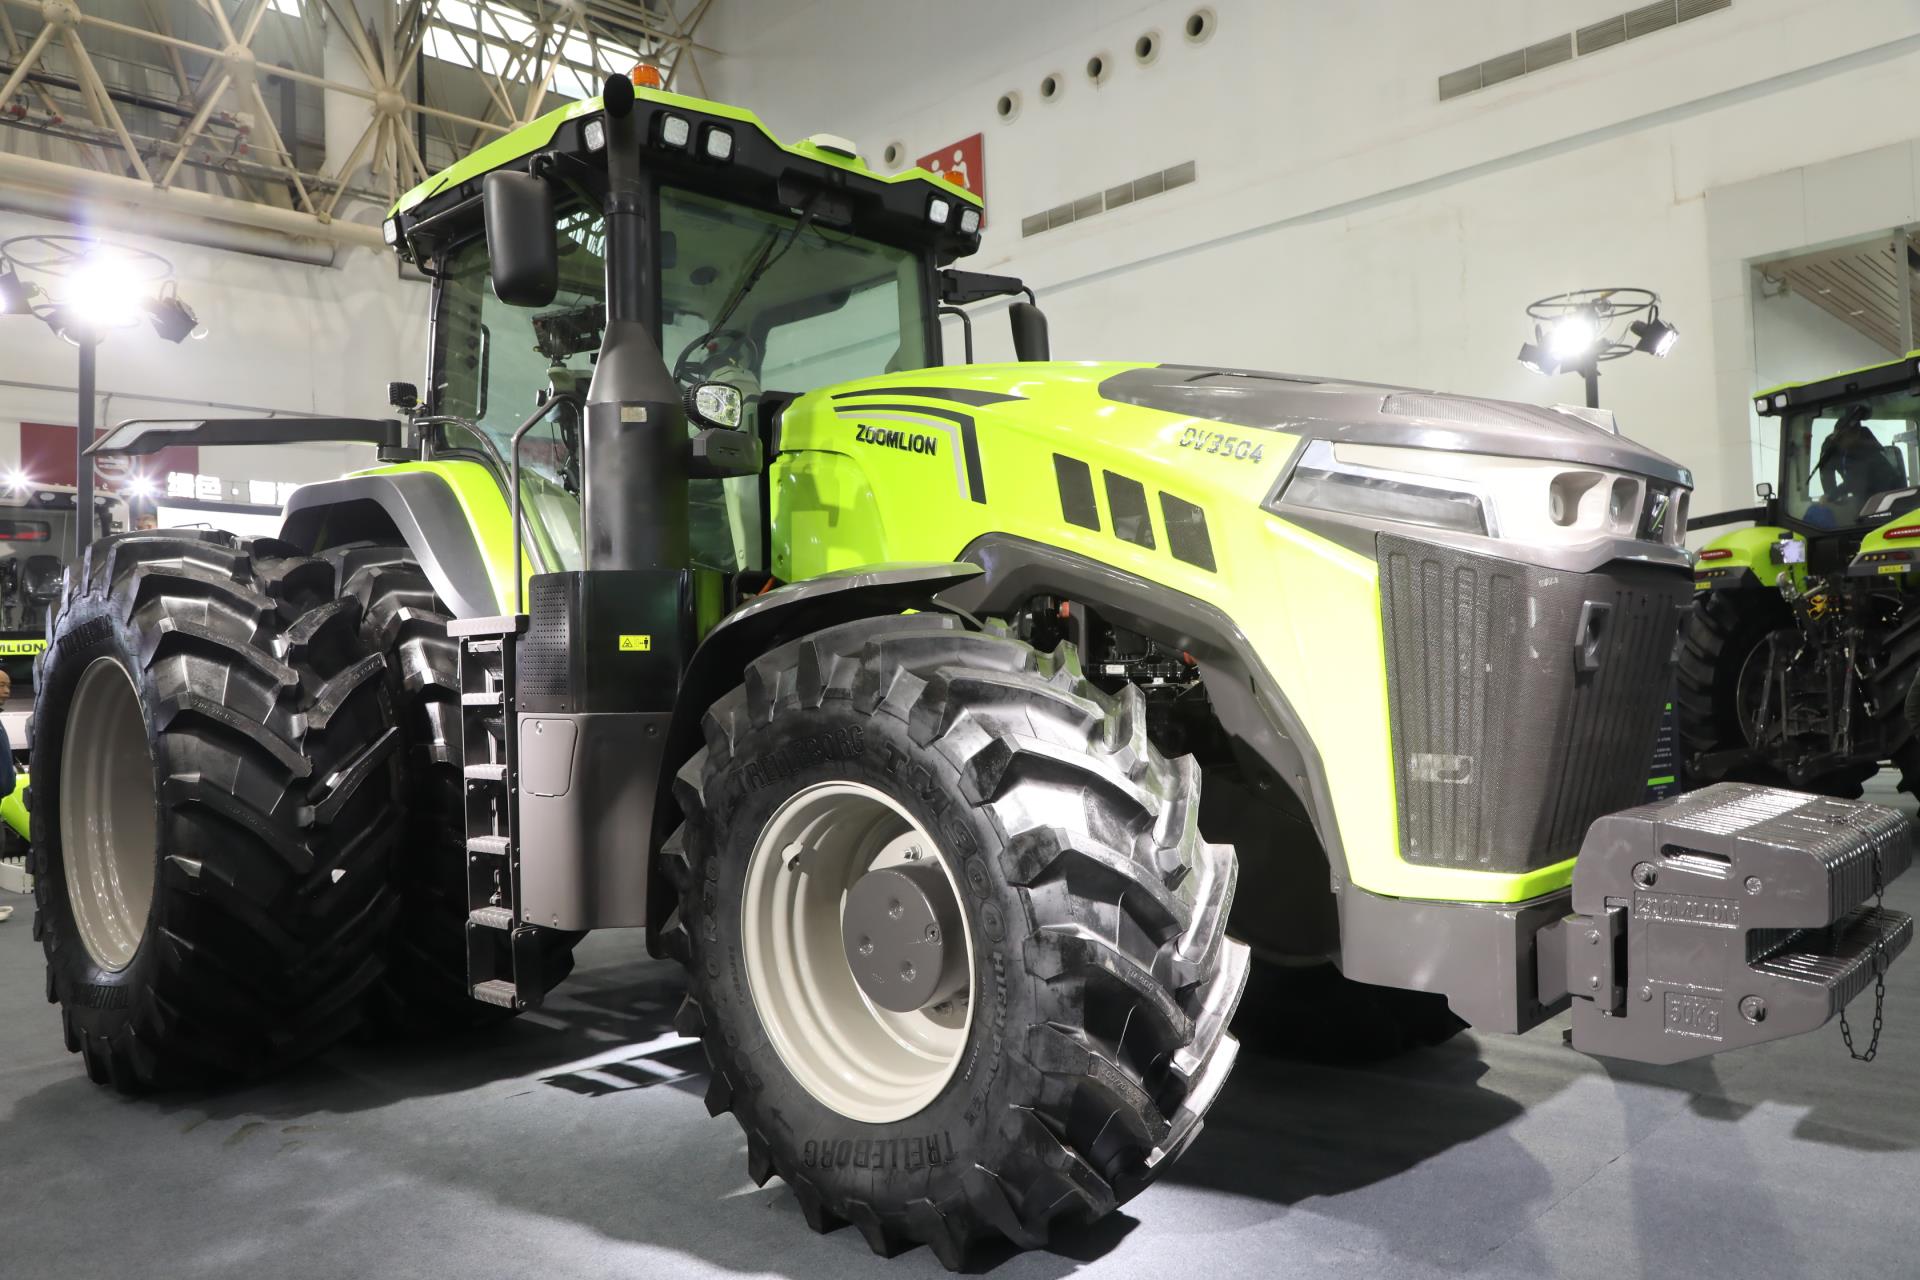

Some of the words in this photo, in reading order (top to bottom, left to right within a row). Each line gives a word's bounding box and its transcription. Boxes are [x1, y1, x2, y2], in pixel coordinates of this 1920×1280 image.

[856, 424, 938, 456] ZOOMLION
[1178, 427, 1265, 464] DV3504
[803, 1130, 959, 1169] TRELLEBORG
